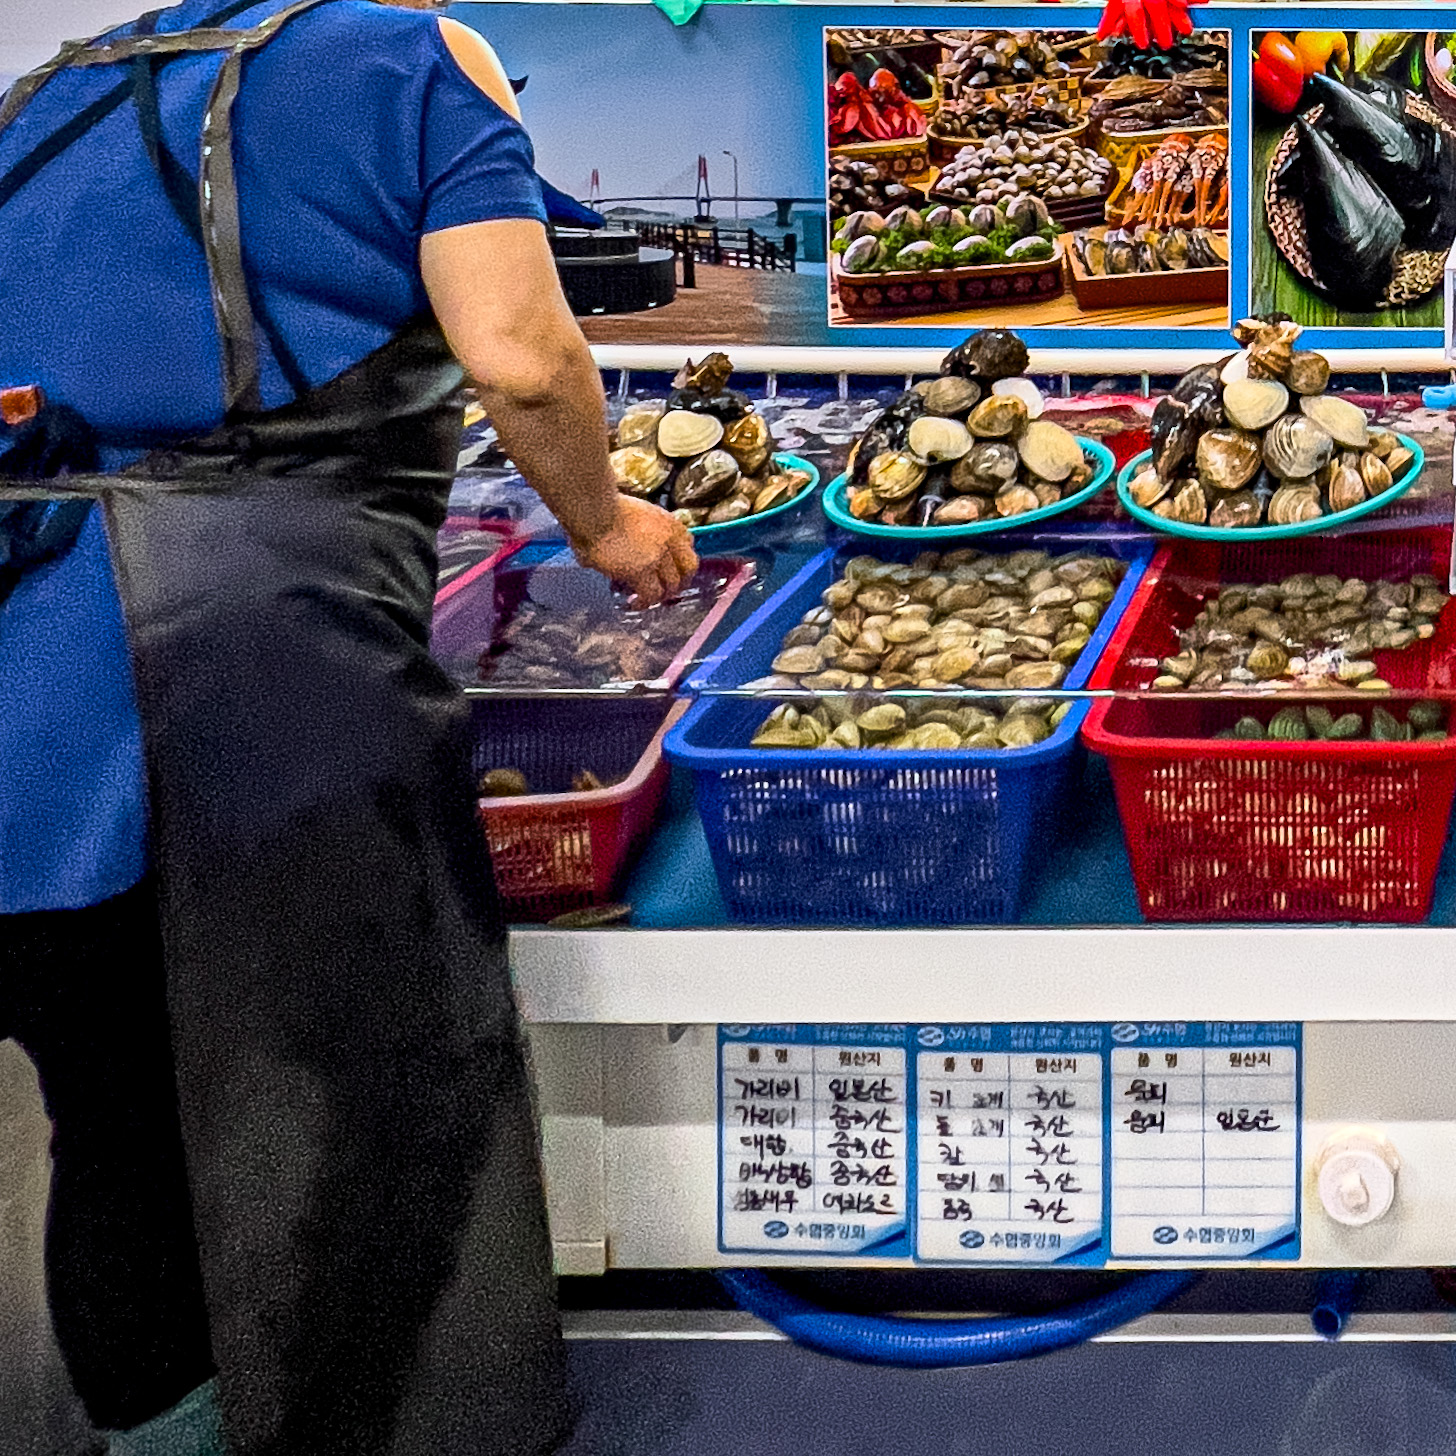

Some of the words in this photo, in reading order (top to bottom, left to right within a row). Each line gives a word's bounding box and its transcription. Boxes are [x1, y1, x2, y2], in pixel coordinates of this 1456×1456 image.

[838, 1051, 881, 1067] 원산지
[1035, 1058, 1077, 1074] 원산지
[1229, 1052, 1271, 1067] 원산지
[734, 1076, 800, 1100] 가리비
[828, 1077, 898, 1102] 일본산
[1027, 1084, 1076, 1110] 국산
[1024, 1114, 1074, 1137] 국산
[1025, 1137, 1079, 1165] 국산
[1024, 1168, 1083, 1193] 국산
[1024, 1197, 1075, 1224] 국산
[794, 1223, 866, 1240] 수협중앙회
[989, 1232, 1061, 1249] 수협중앙회
[1183, 1226, 1255, 1244] 수협중앙회
